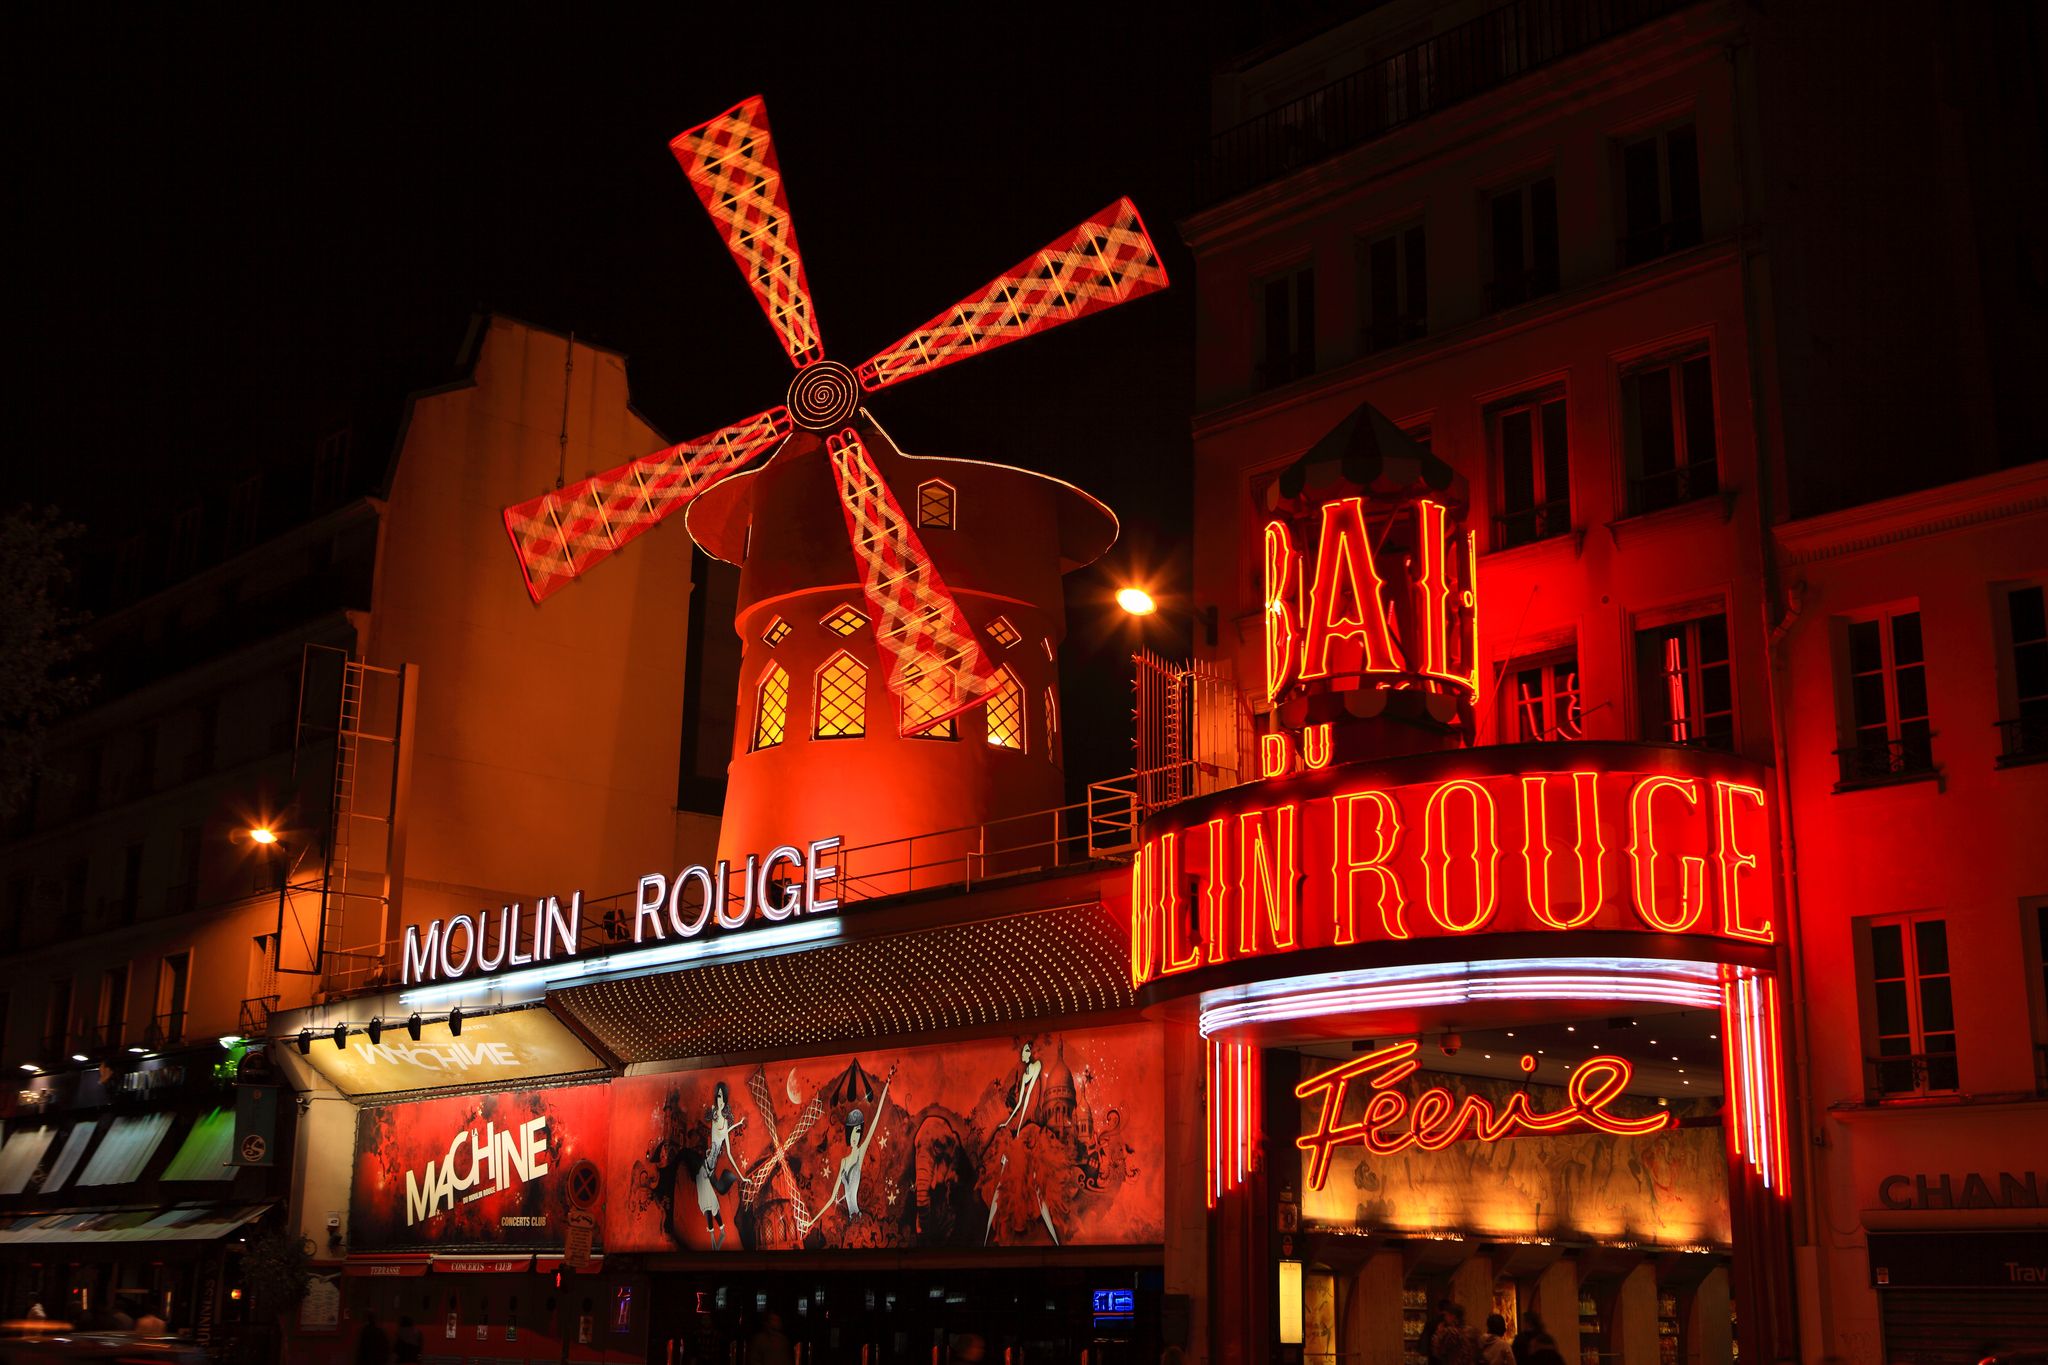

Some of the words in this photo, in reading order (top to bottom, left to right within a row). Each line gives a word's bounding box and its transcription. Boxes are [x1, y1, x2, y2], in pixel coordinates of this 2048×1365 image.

[1265, 497, 1479, 703] BAL
[1262, 725, 1331, 777] DU
[1332, 772, 1774, 944] ROUGE
[402, 890, 583, 985] MOULIN
[634, 835, 845, 943] ROUGE
[1295, 1039, 1671, 1191] Féerie
[406, 1115, 548, 1228] MACHINE
[1878, 1170, 2048, 1210] CHAN
[501, 1216, 530, 1227] CONCERTS
[531, 1216, 547, 1227] CLUB
[370, 1266, 401, 1275] TERRASSE
[451, 1262, 485, 1272] CONCERTS
[494, 1261, 513, 1272] CLUB
